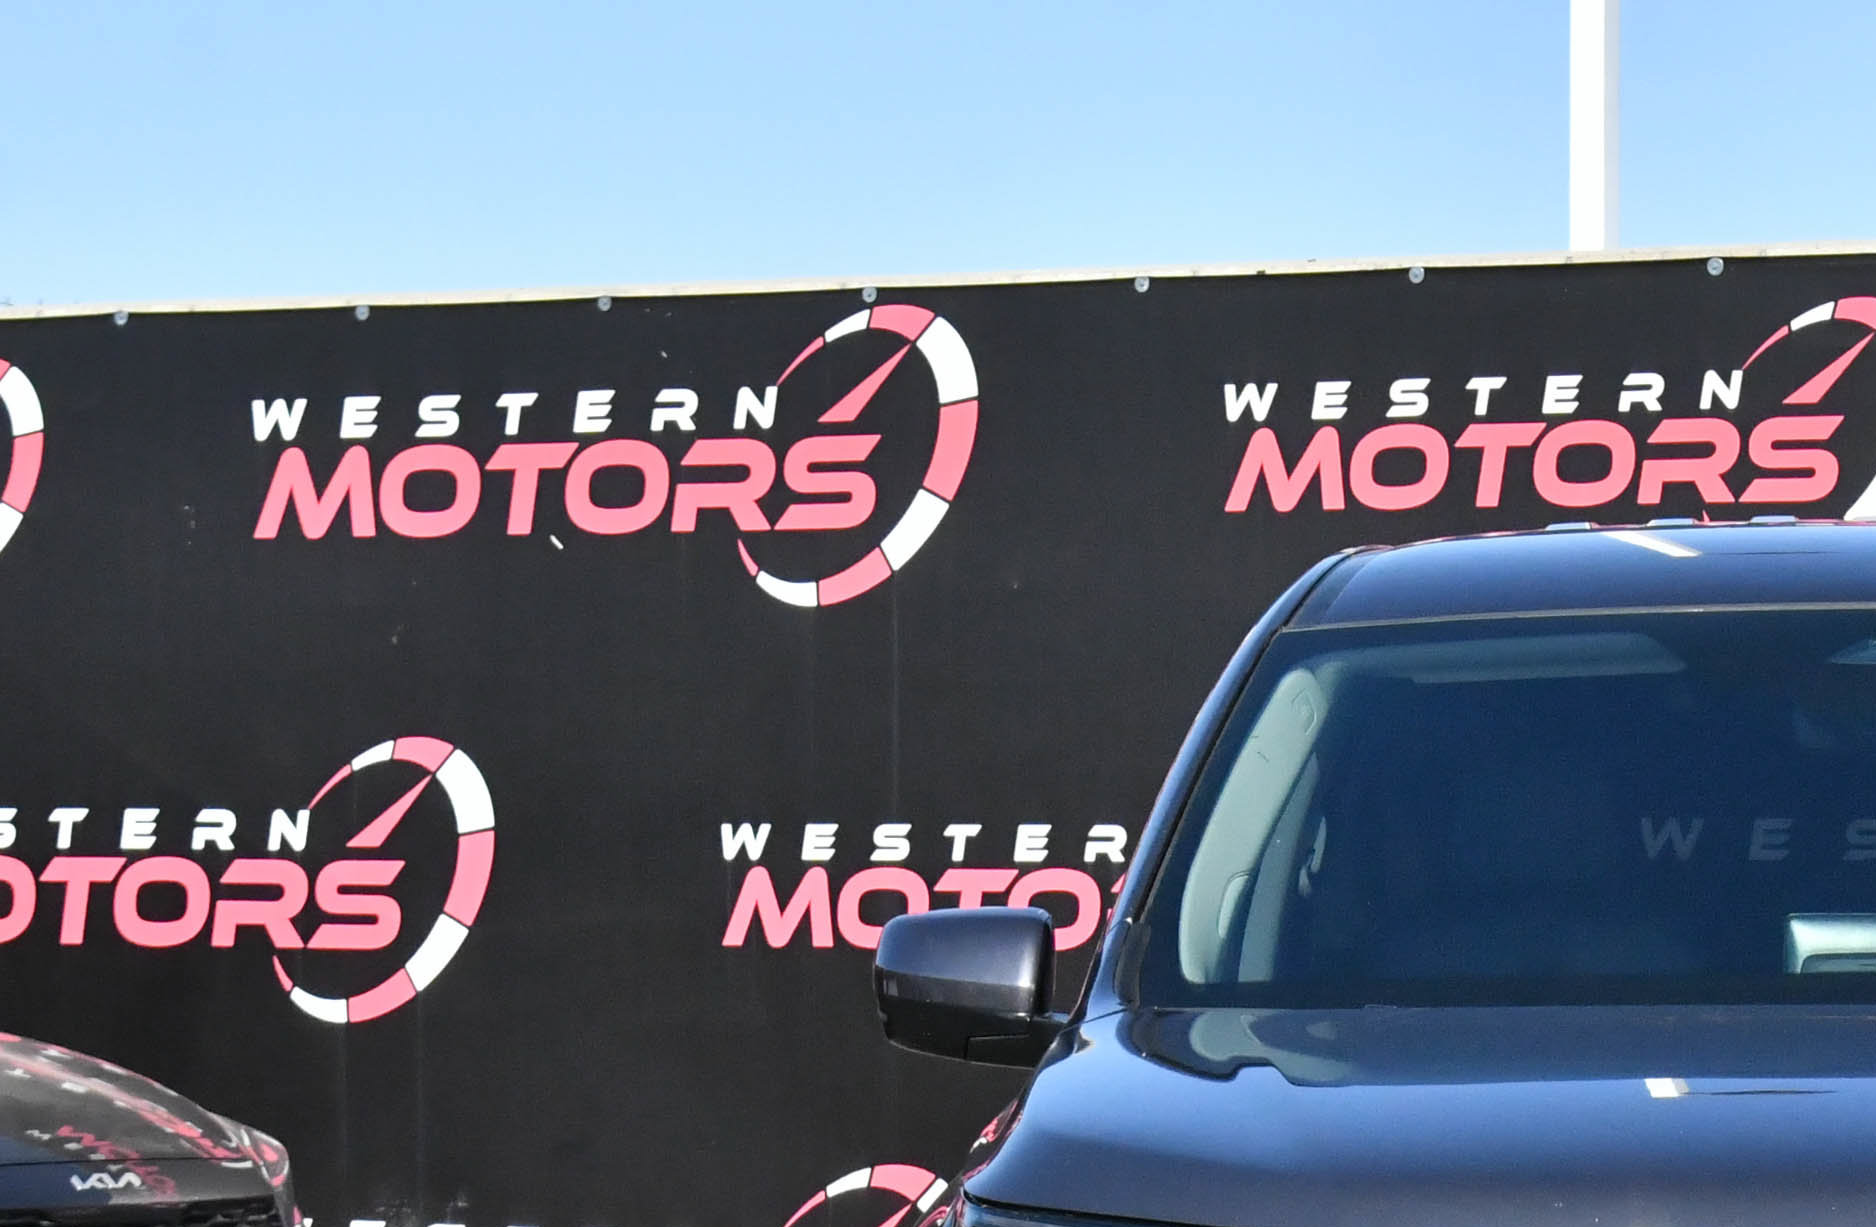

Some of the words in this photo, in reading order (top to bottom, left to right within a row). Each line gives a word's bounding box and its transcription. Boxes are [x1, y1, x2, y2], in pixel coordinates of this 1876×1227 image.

[251, 385, 779, 442] WESTERN
[1223, 369, 1744, 423] WESTERN
[252, 433, 883, 541] MOTORS
[1223, 414, 1845, 513] MOTORS
[720, 823, 1128, 864] WESTER
